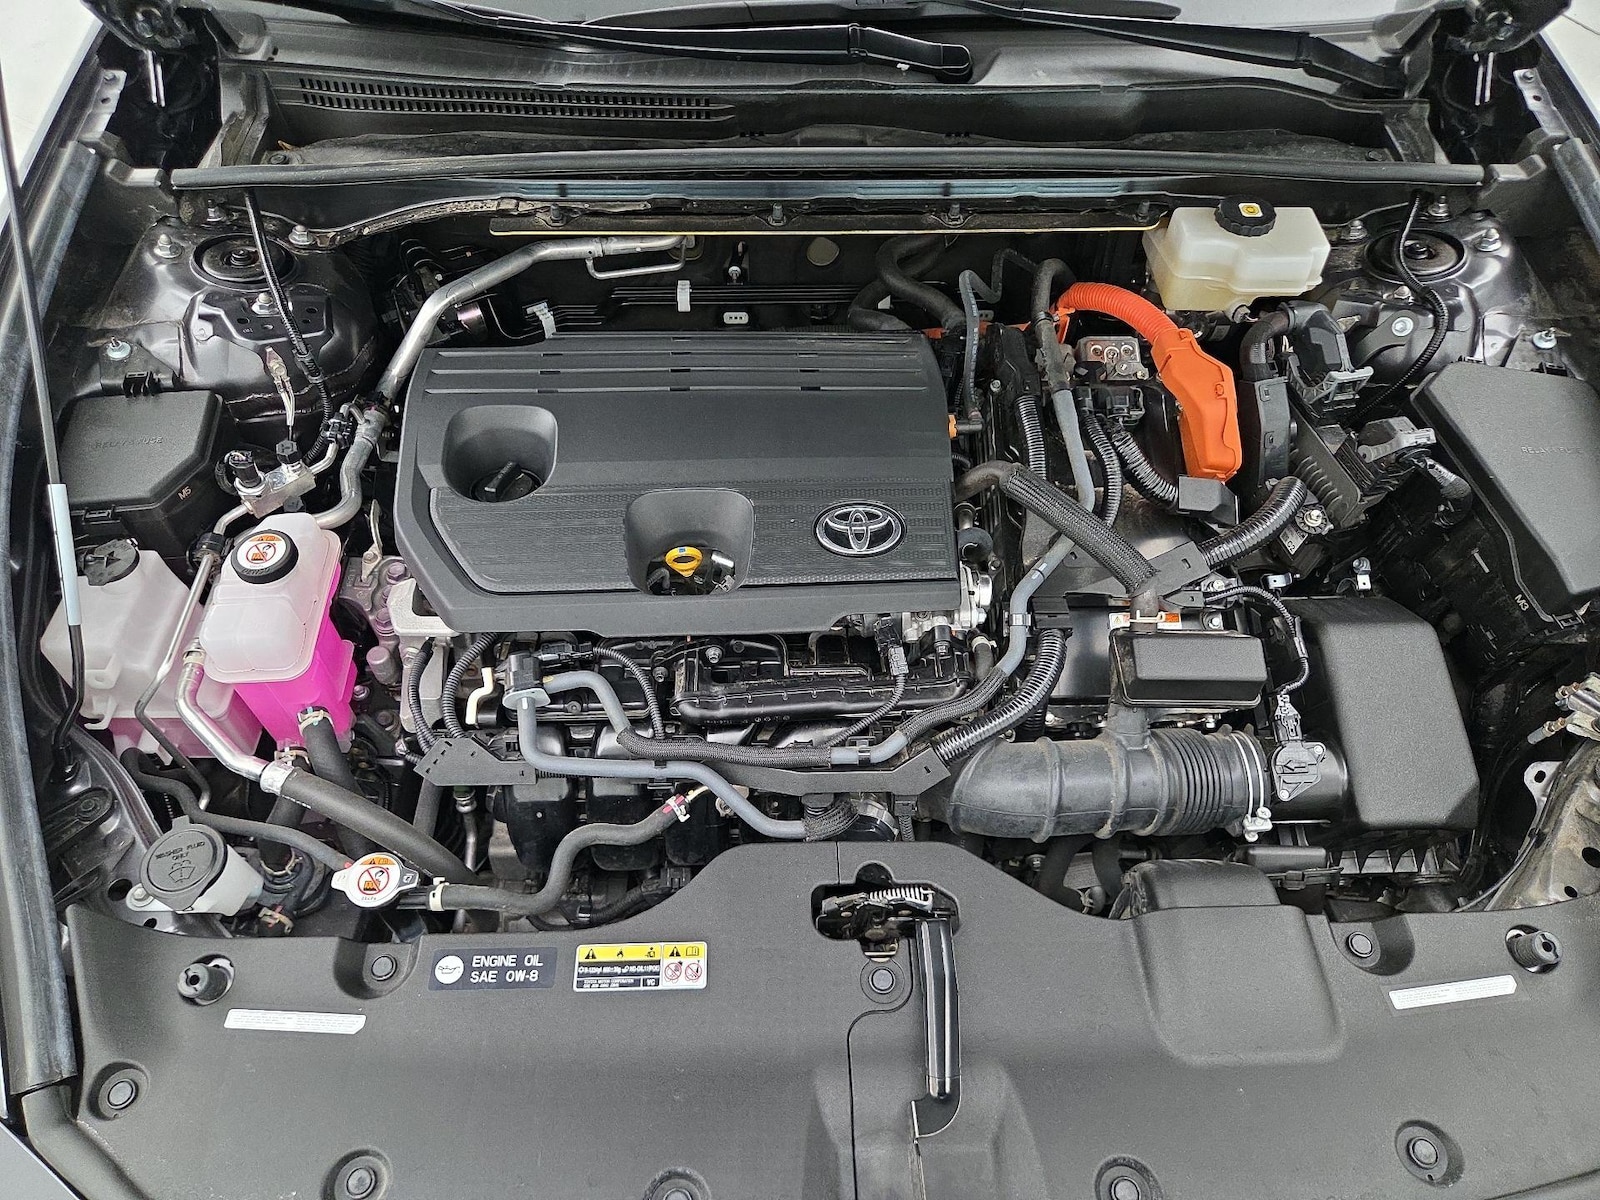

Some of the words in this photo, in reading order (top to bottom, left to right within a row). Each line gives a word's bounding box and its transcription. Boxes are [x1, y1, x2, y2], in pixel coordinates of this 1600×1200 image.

[177, 486, 192, 501] M5
[1514, 594, 1530, 611] M3
[471, 955, 517, 967] ENGINE
[524, 954, 544, 967] OIL
[470, 970, 498, 983] SAE
[505, 970, 538, 983] 0W-8
